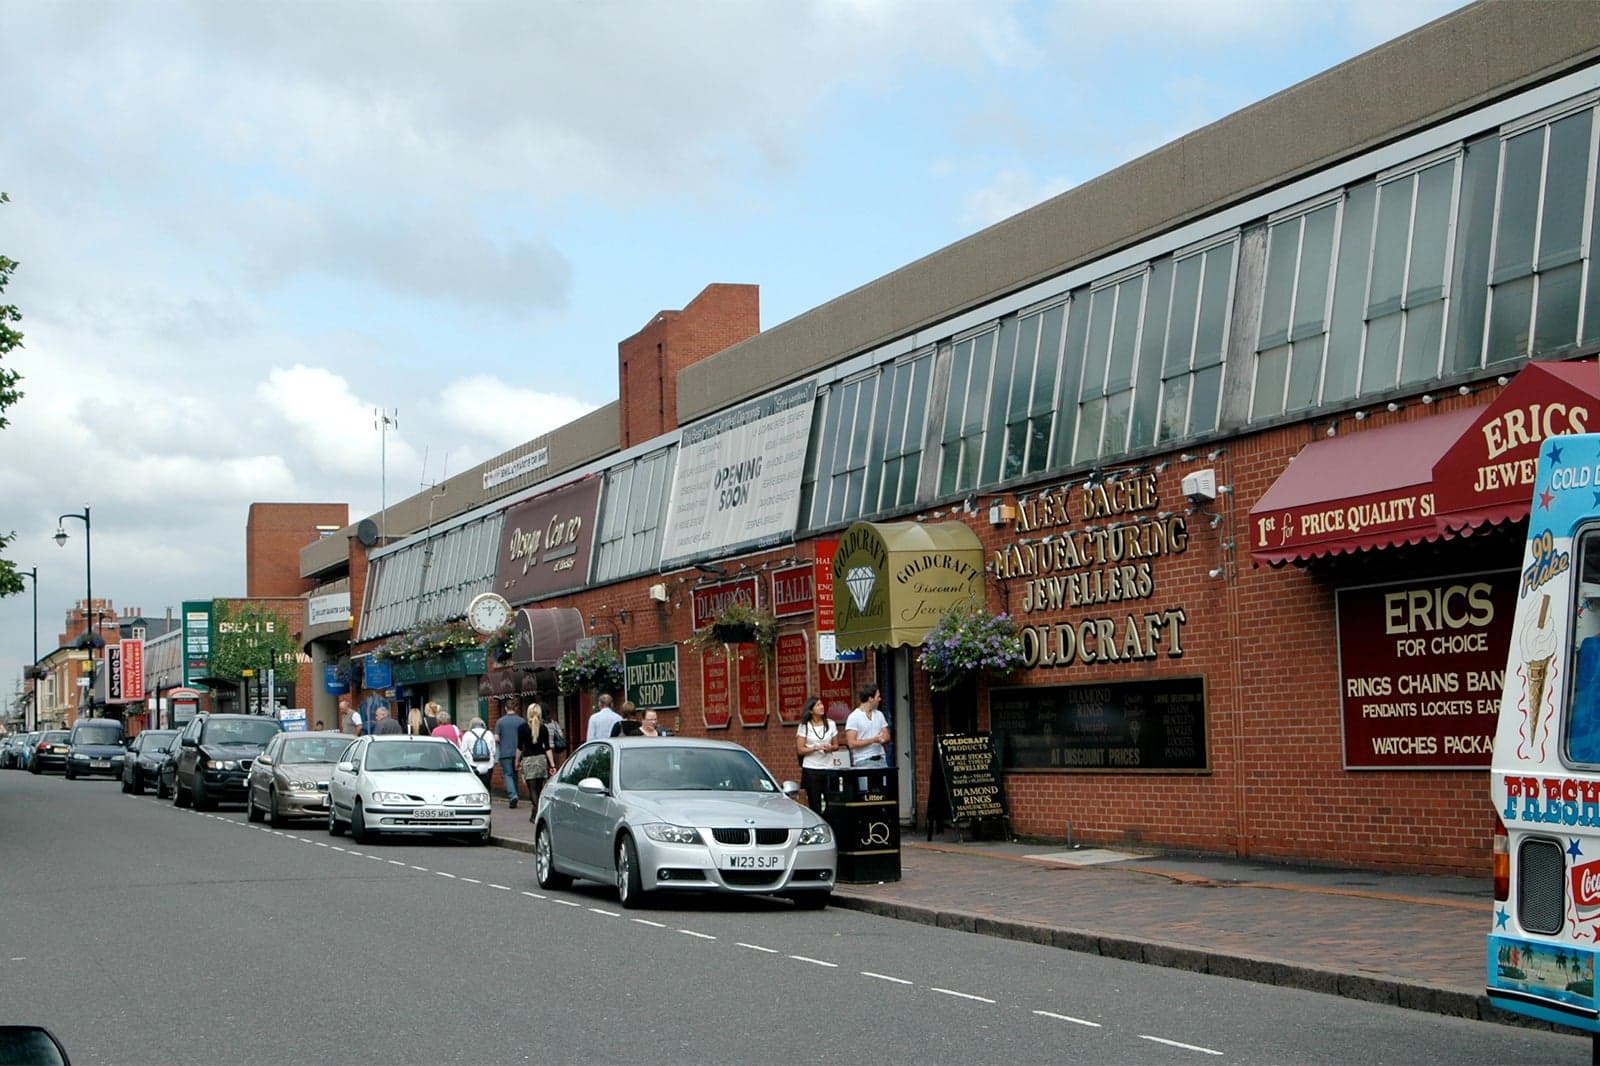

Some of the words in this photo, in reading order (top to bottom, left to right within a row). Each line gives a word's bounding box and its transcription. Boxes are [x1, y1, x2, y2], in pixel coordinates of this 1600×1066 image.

[1482, 403, 1588, 460] ERICS
[714, 455, 763, 490] OPENING
[1552, 465, 1591, 491] COLD
[718, 483, 750, 512] SOON
[1015, 492, 1071, 533] ALEX
[1081, 473, 1158, 521] BACHE
[545, 514, 581, 550] Cenre
[1257, 516, 1276, 547] 1st
[1280, 513, 1295, 546] for
[1301, 509, 1345, 536] PRICE
[1348, 497, 1416, 532] QUALITY
[833, 528, 888, 579] GOLDCRAFT
[994, 516, 1188, 579] MANUFACTURING
[1532, 528, 1553, 567] 99
[897, 554, 978, 585] GOLDCRAFT
[913, 582, 964, 593] Discount
[1023, 562, 1154, 613] JEWELLERS
[1385, 582, 1494, 635] ERICS
[1021, 608, 1186, 668] OLDCRAFT
[1396, 639, 1426, 657] FOR
[1431, 632, 1488, 655] CHOICE
[627, 661, 677, 691] JEWELLERS
[1347, 676, 1392, 697] RINGS
[1398, 672, 1459, 694] CHAINS
[639, 684, 664, 706] SHOP
[1362, 702, 1417, 718] PENDANTS
[1421, 700, 1472, 716] LOCKETS
[943, 737, 989, 745] GOLDCRAFT
[947, 744, 988, 752] PRODUCTS
[1372, 737, 1437, 755] WATCHES
[1444, 735, 1496, 754] PACKA
[1064, 749, 1105, 765] DISCOUNT
[1109, 749, 1141, 765] PRICES
[953, 786, 998, 797] DIAMOND
[963, 795, 992, 804] RINGS
[1504, 776, 1600, 827] FRESH
[730, 856, 755, 868] W123
[757, 856, 778, 868] SJP
